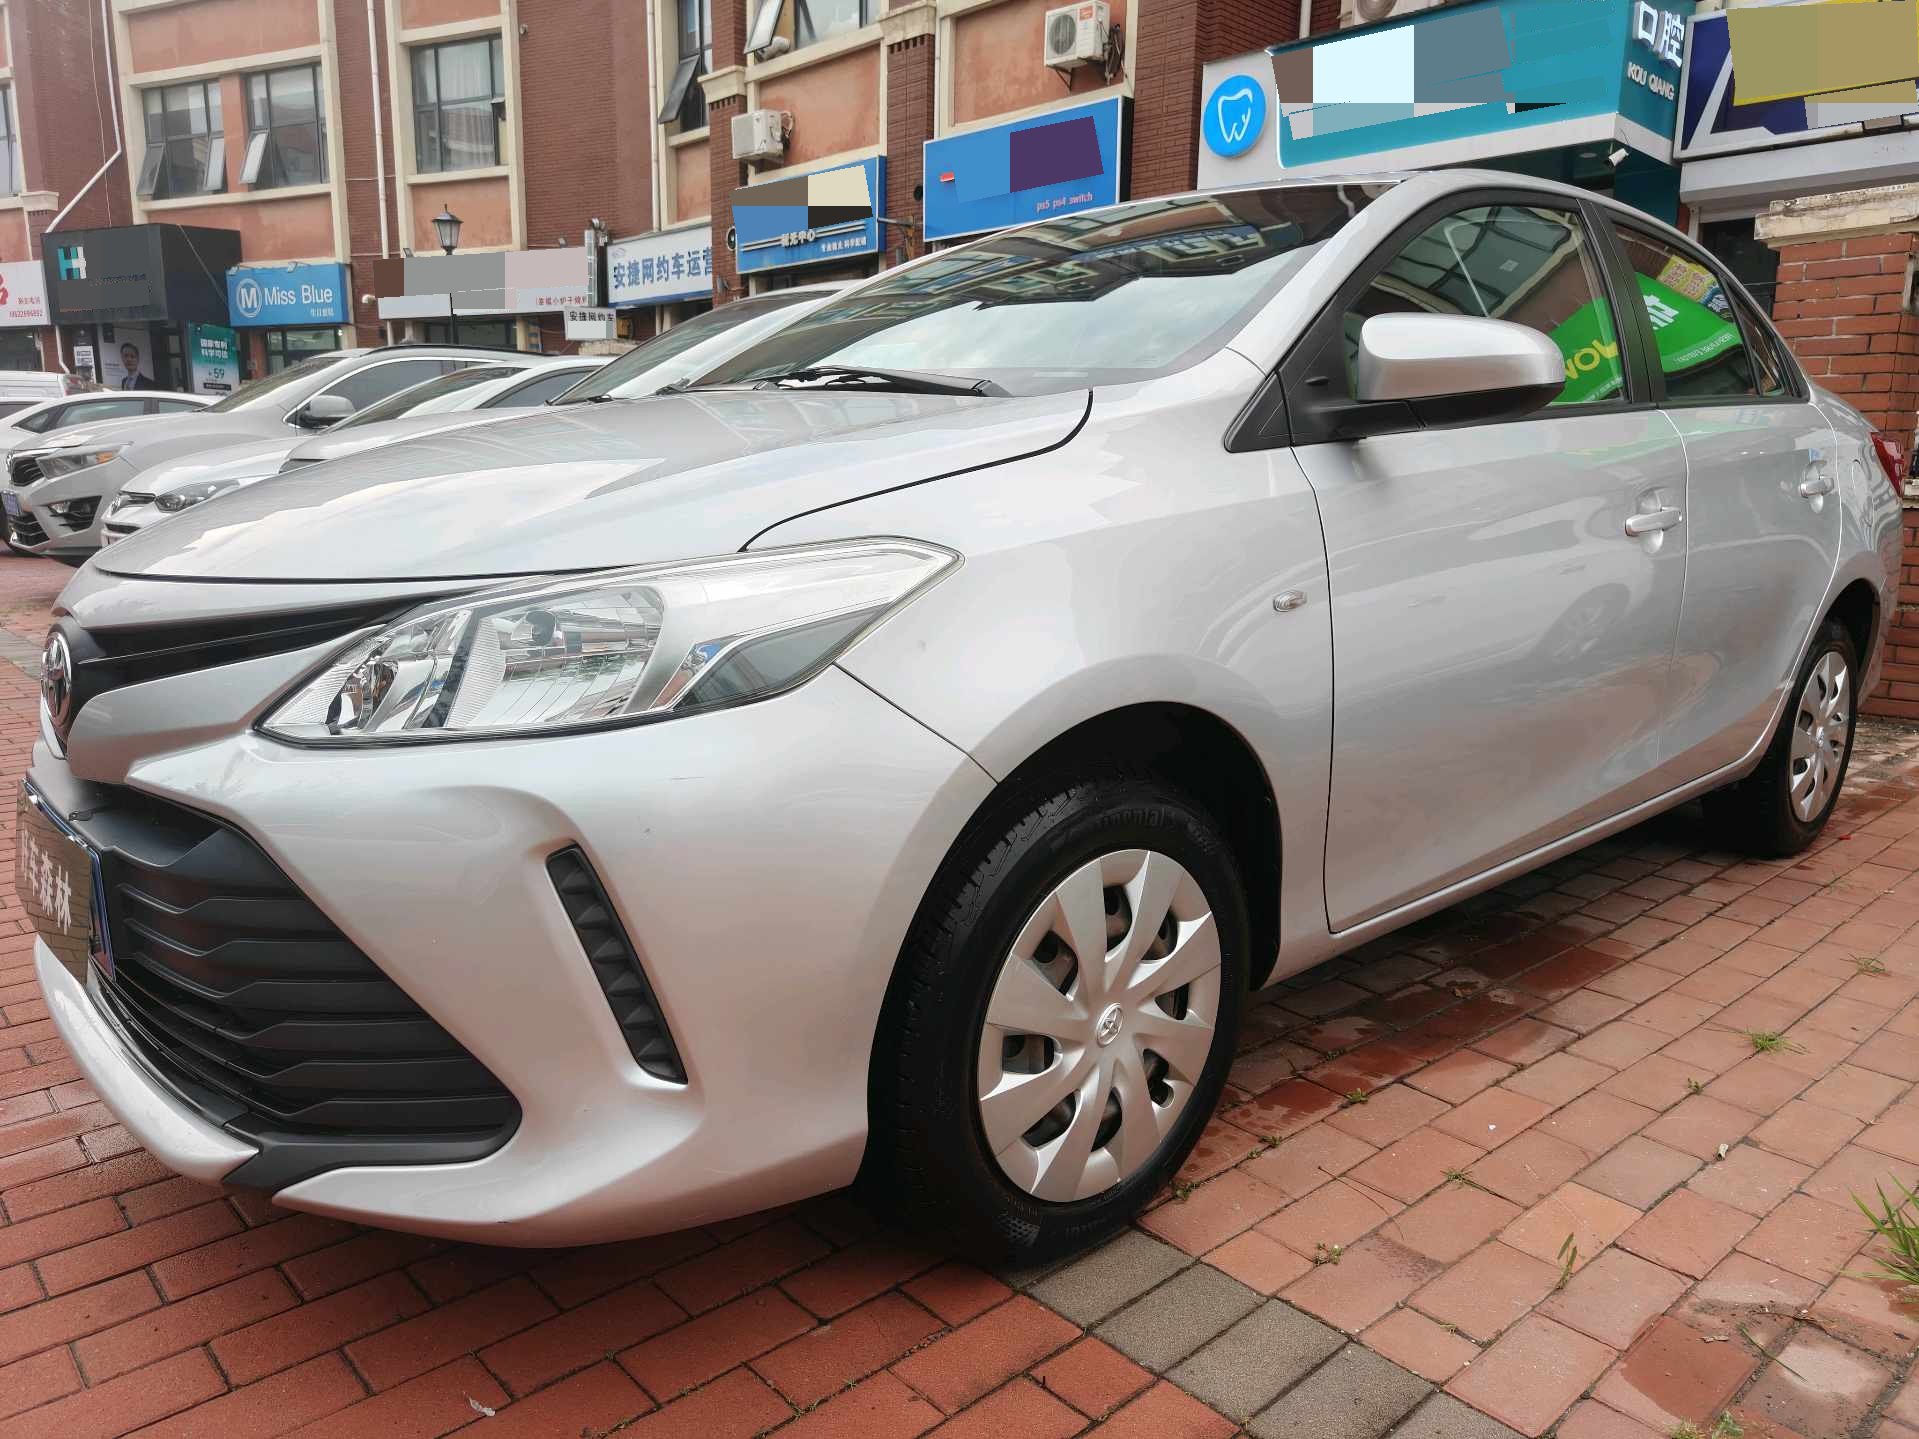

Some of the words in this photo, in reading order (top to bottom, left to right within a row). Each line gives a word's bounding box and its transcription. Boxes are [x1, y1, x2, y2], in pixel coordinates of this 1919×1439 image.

[1633, 0, 1684, 68] 口腔
[1627, 62, 1647, 85] KOU
[1648, 74, 1675, 100] QIANG
[1069, 192, 1093, 205] switch
[264, 286, 296, 305] Miss
[301, 283, 333, 304] Blue
